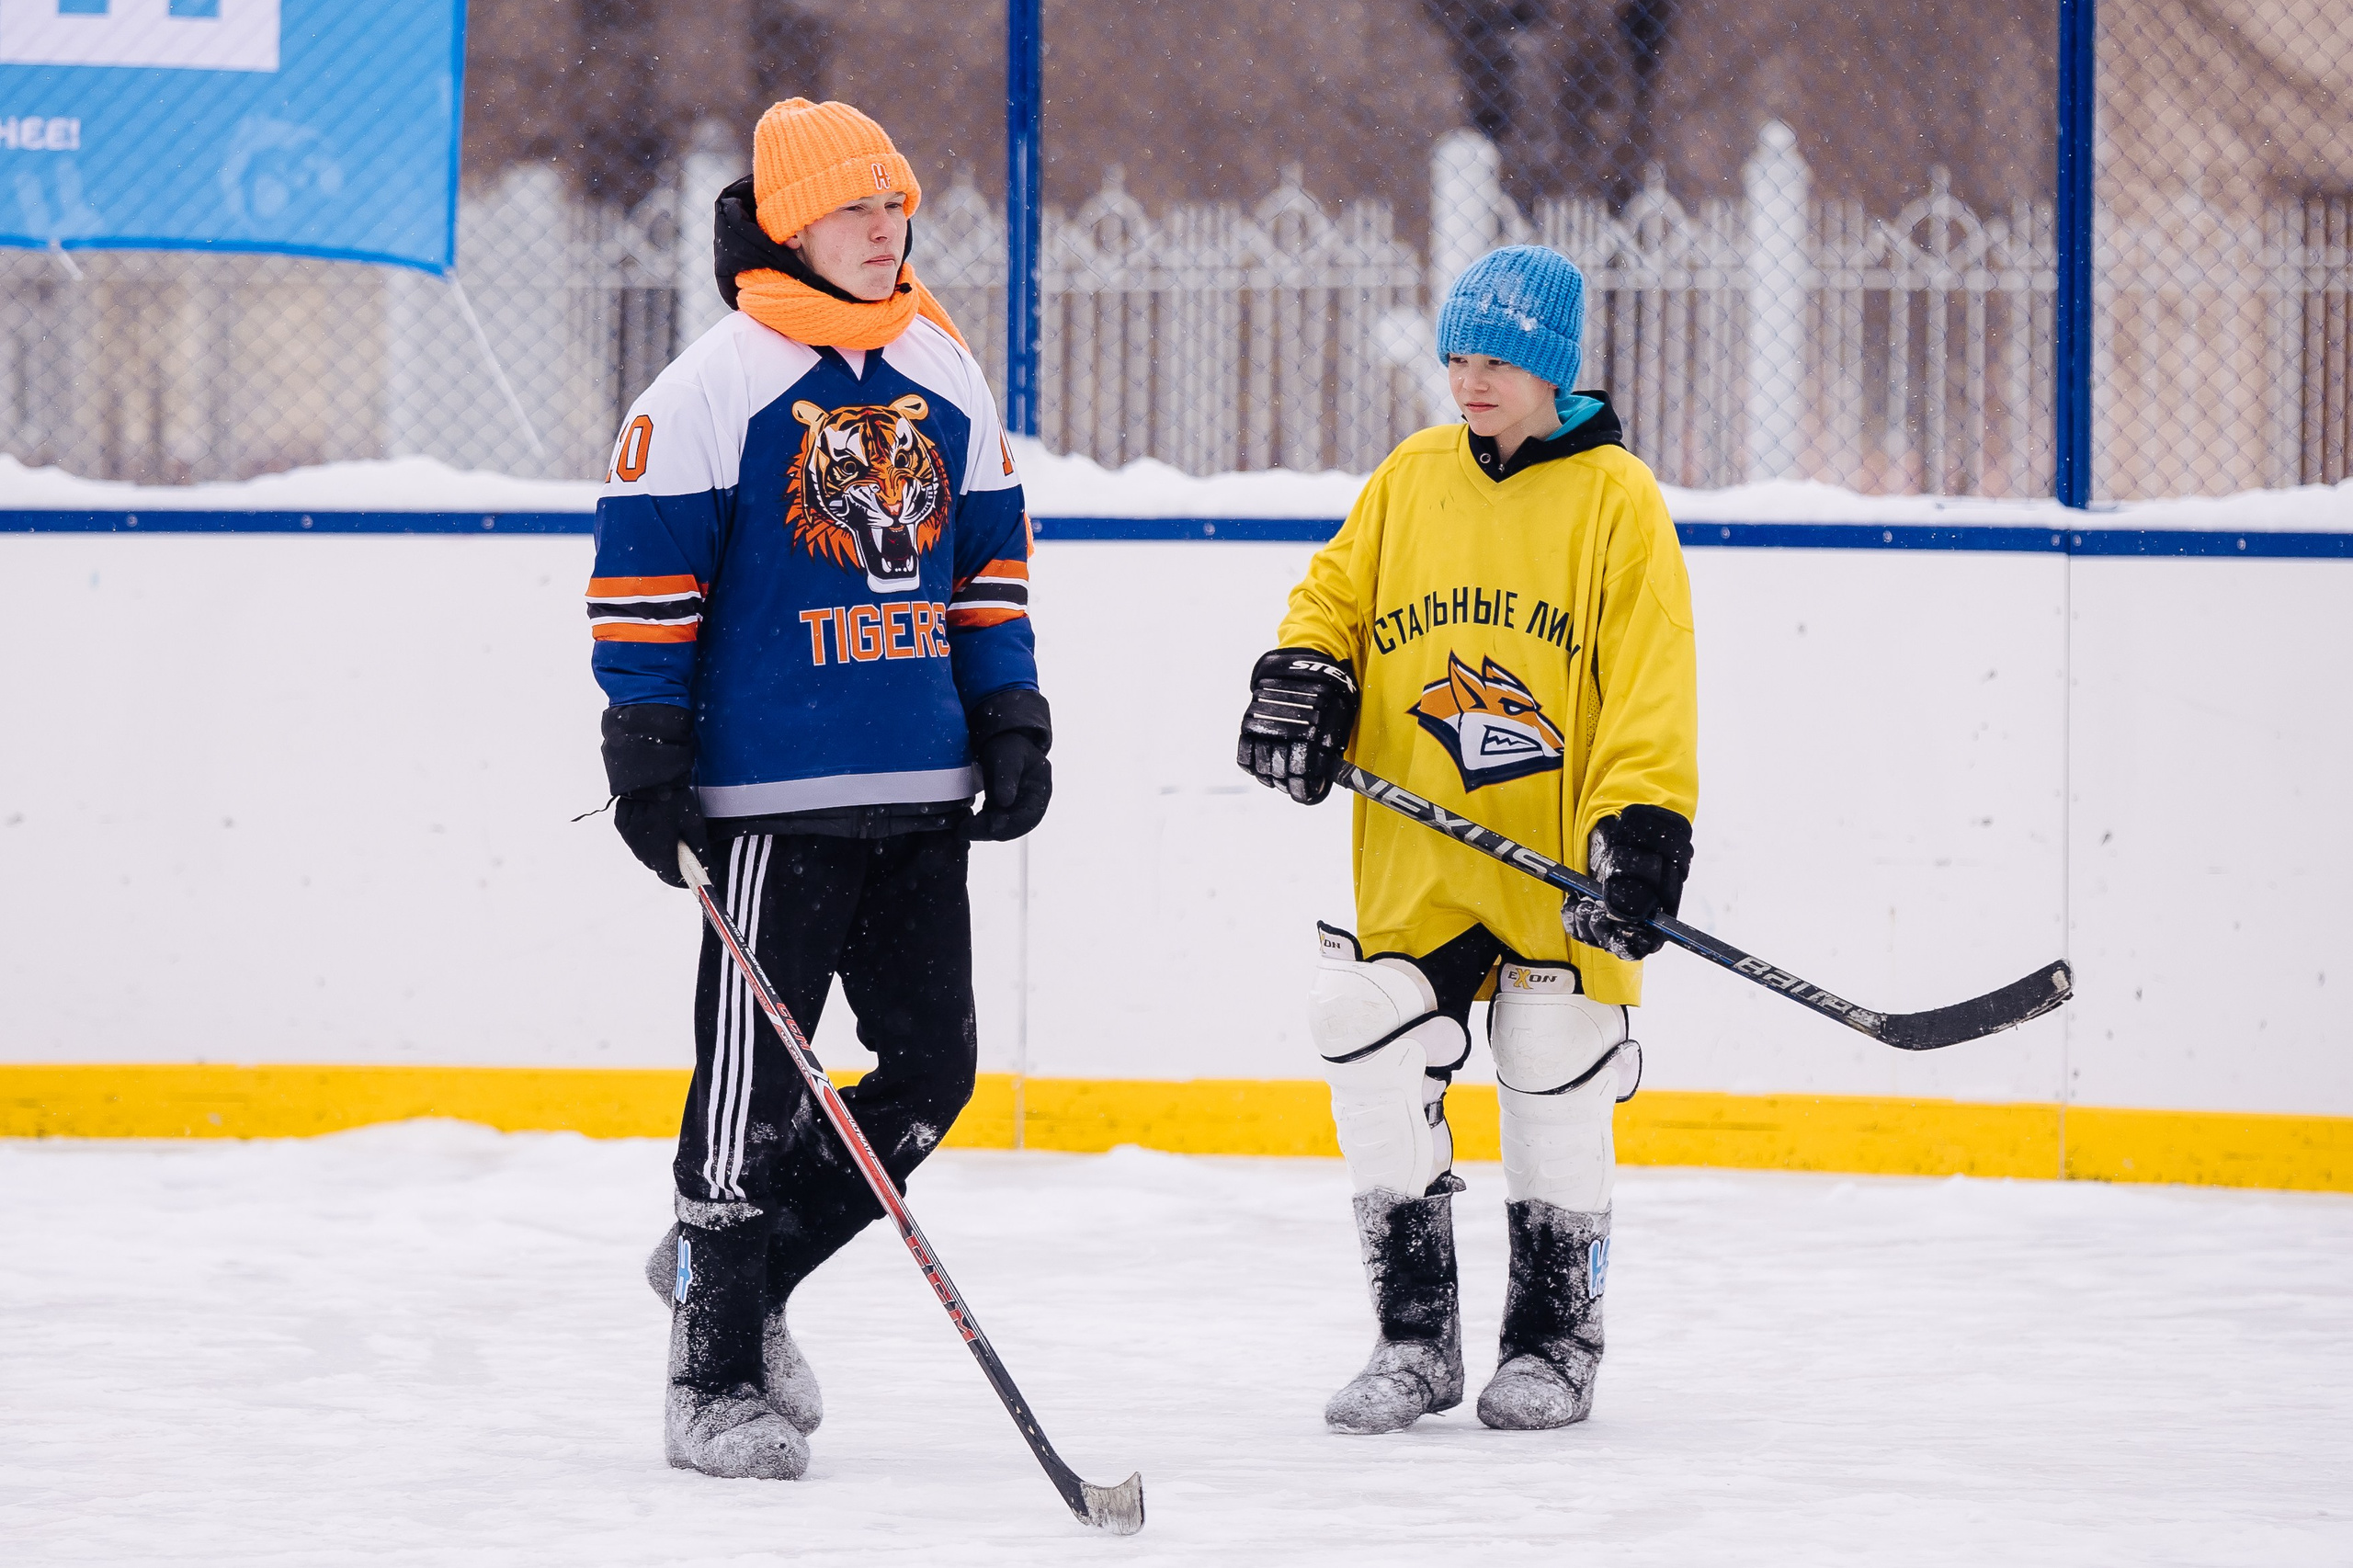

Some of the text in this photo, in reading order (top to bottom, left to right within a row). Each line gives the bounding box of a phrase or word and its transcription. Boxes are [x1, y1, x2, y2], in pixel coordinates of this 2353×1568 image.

[799, 600, 950, 666] TIGERS
[1373, 586, 1518, 655] СТАЛЬНЫЕ
[1289, 660, 1357, 694] STEX
[1507, 968, 1558, 990] EXON
[776, 1002, 812, 1051] CCM
[904, 1230, 978, 1344] CCM
